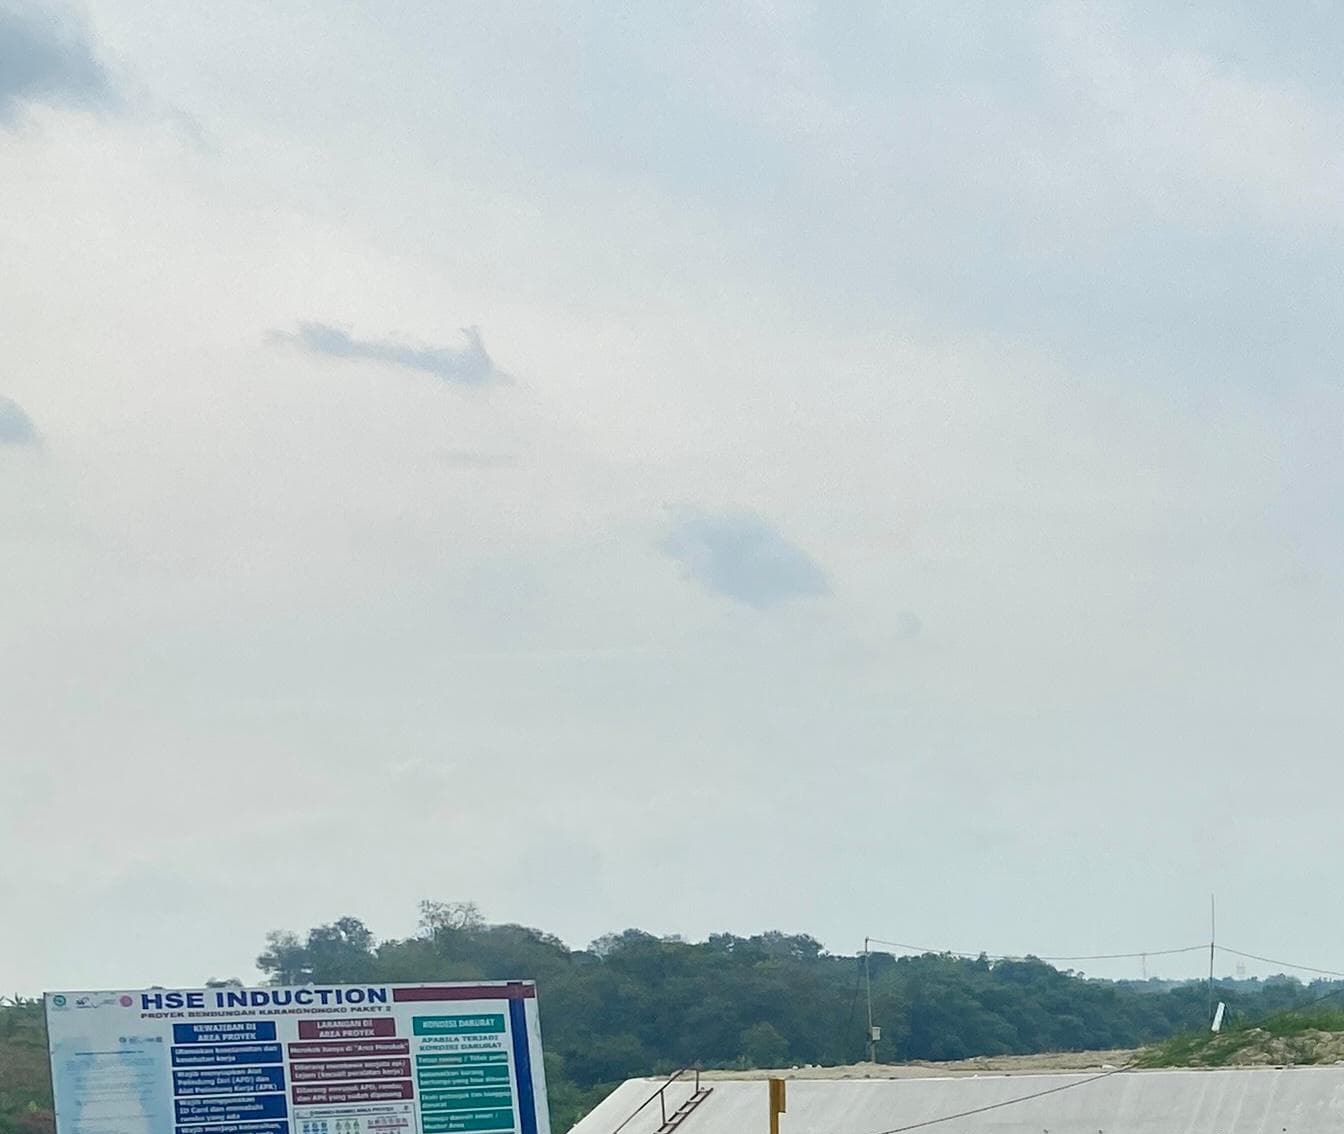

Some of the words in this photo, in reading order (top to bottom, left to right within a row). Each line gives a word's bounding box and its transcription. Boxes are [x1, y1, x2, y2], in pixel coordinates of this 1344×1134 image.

[141, 992, 205, 1010] HSE
[215, 988, 387, 1009] INDUCTION
[188, 1010, 256, 1018] BENDUNGAN
[258, 1007, 348, 1015] KARANGNONGKO
[350, 1006, 383, 1014] PAKET
[193, 1023, 244, 1033] KEWAJIBAN
[245, 1023, 257, 1031] DI
[316, 1020, 361, 1029] LARANGAN
[363, 1019, 373, 1027] DI
[197, 1033, 220, 1041] AREA
[222, 1032, 257, 1040] PROYEK
[319, 1030, 340, 1038] AREA
[342, 1029, 375, 1037] PROYEK
